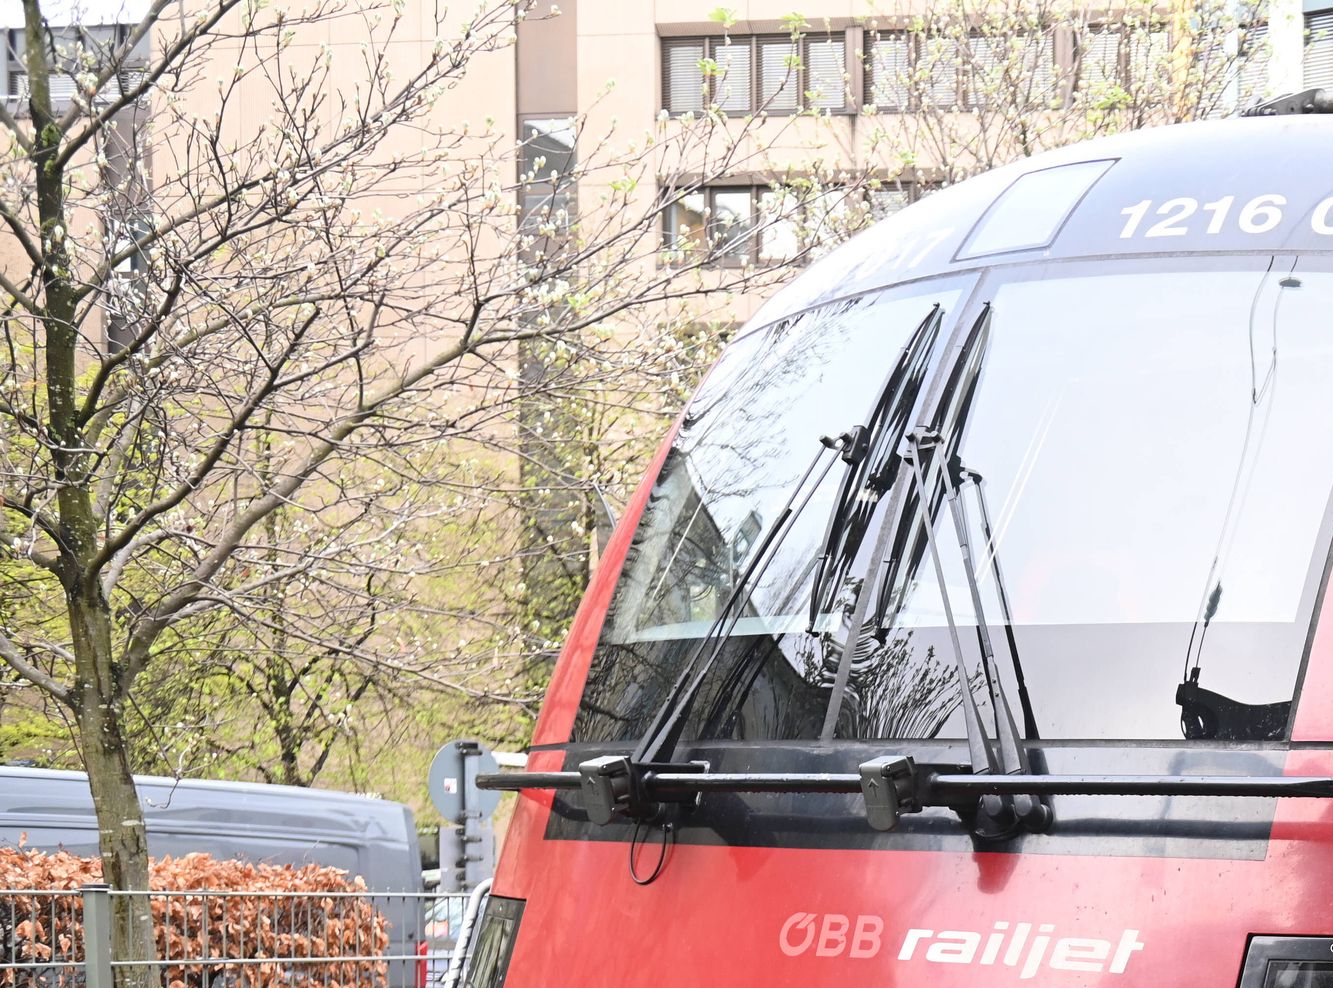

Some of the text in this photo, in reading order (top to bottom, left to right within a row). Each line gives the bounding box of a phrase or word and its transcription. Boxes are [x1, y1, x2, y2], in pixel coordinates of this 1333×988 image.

[1117, 195, 1286, 239] 1216
[779, 912, 1145, 979] ÖBB railjet
